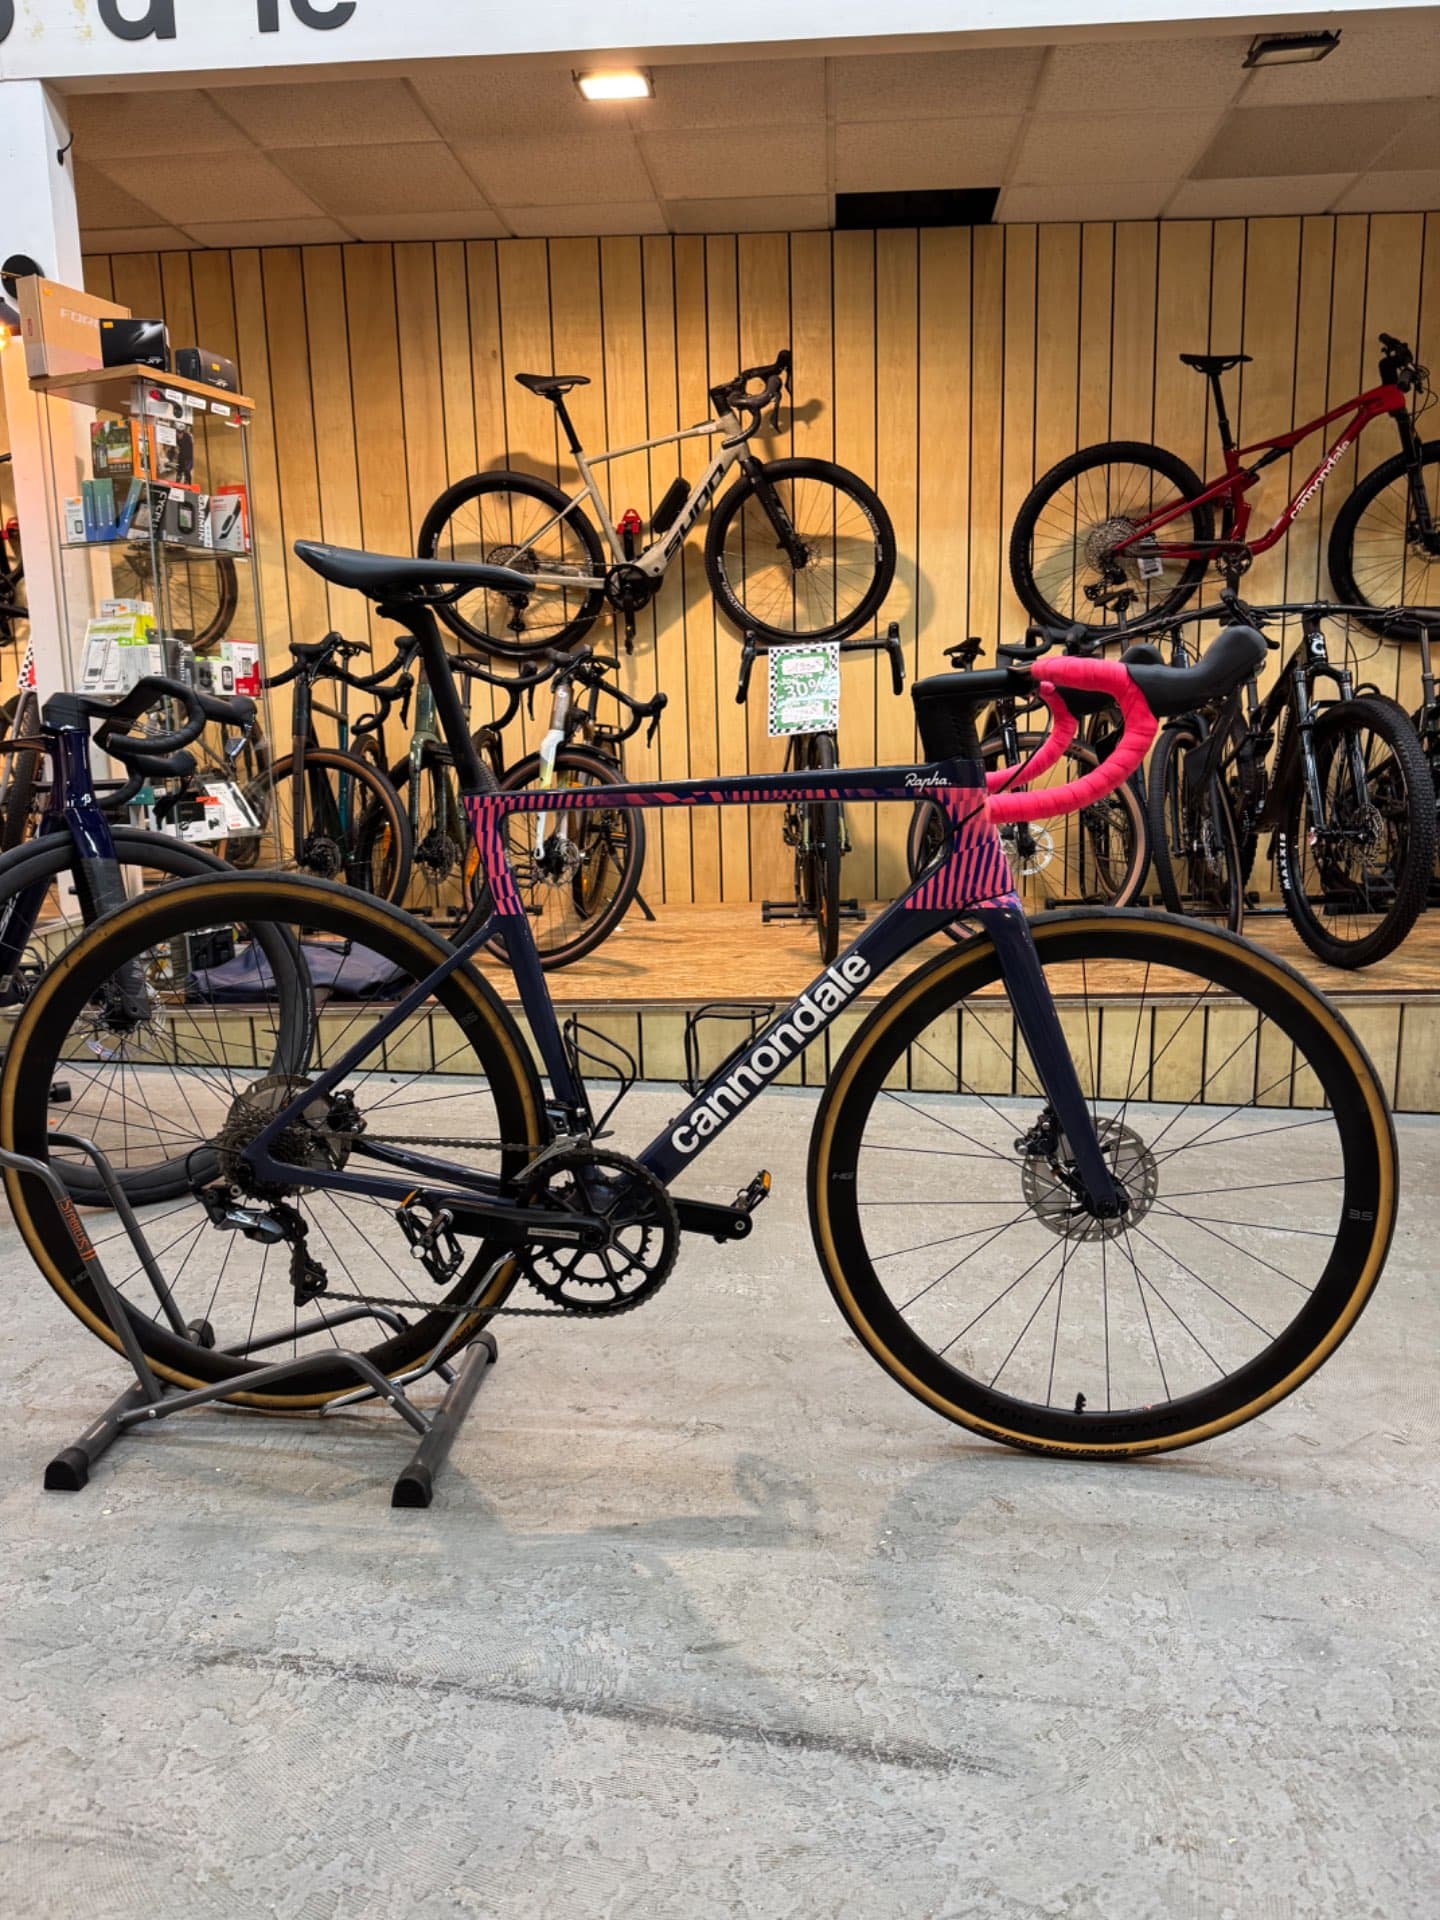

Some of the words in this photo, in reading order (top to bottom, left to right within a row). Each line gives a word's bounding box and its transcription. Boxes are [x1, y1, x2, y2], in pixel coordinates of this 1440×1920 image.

[1290, 439, 1350, 520] cannondale
[1279, 832, 1291, 890] MAXXIS
[671, 953, 872, 1154] cannondale
